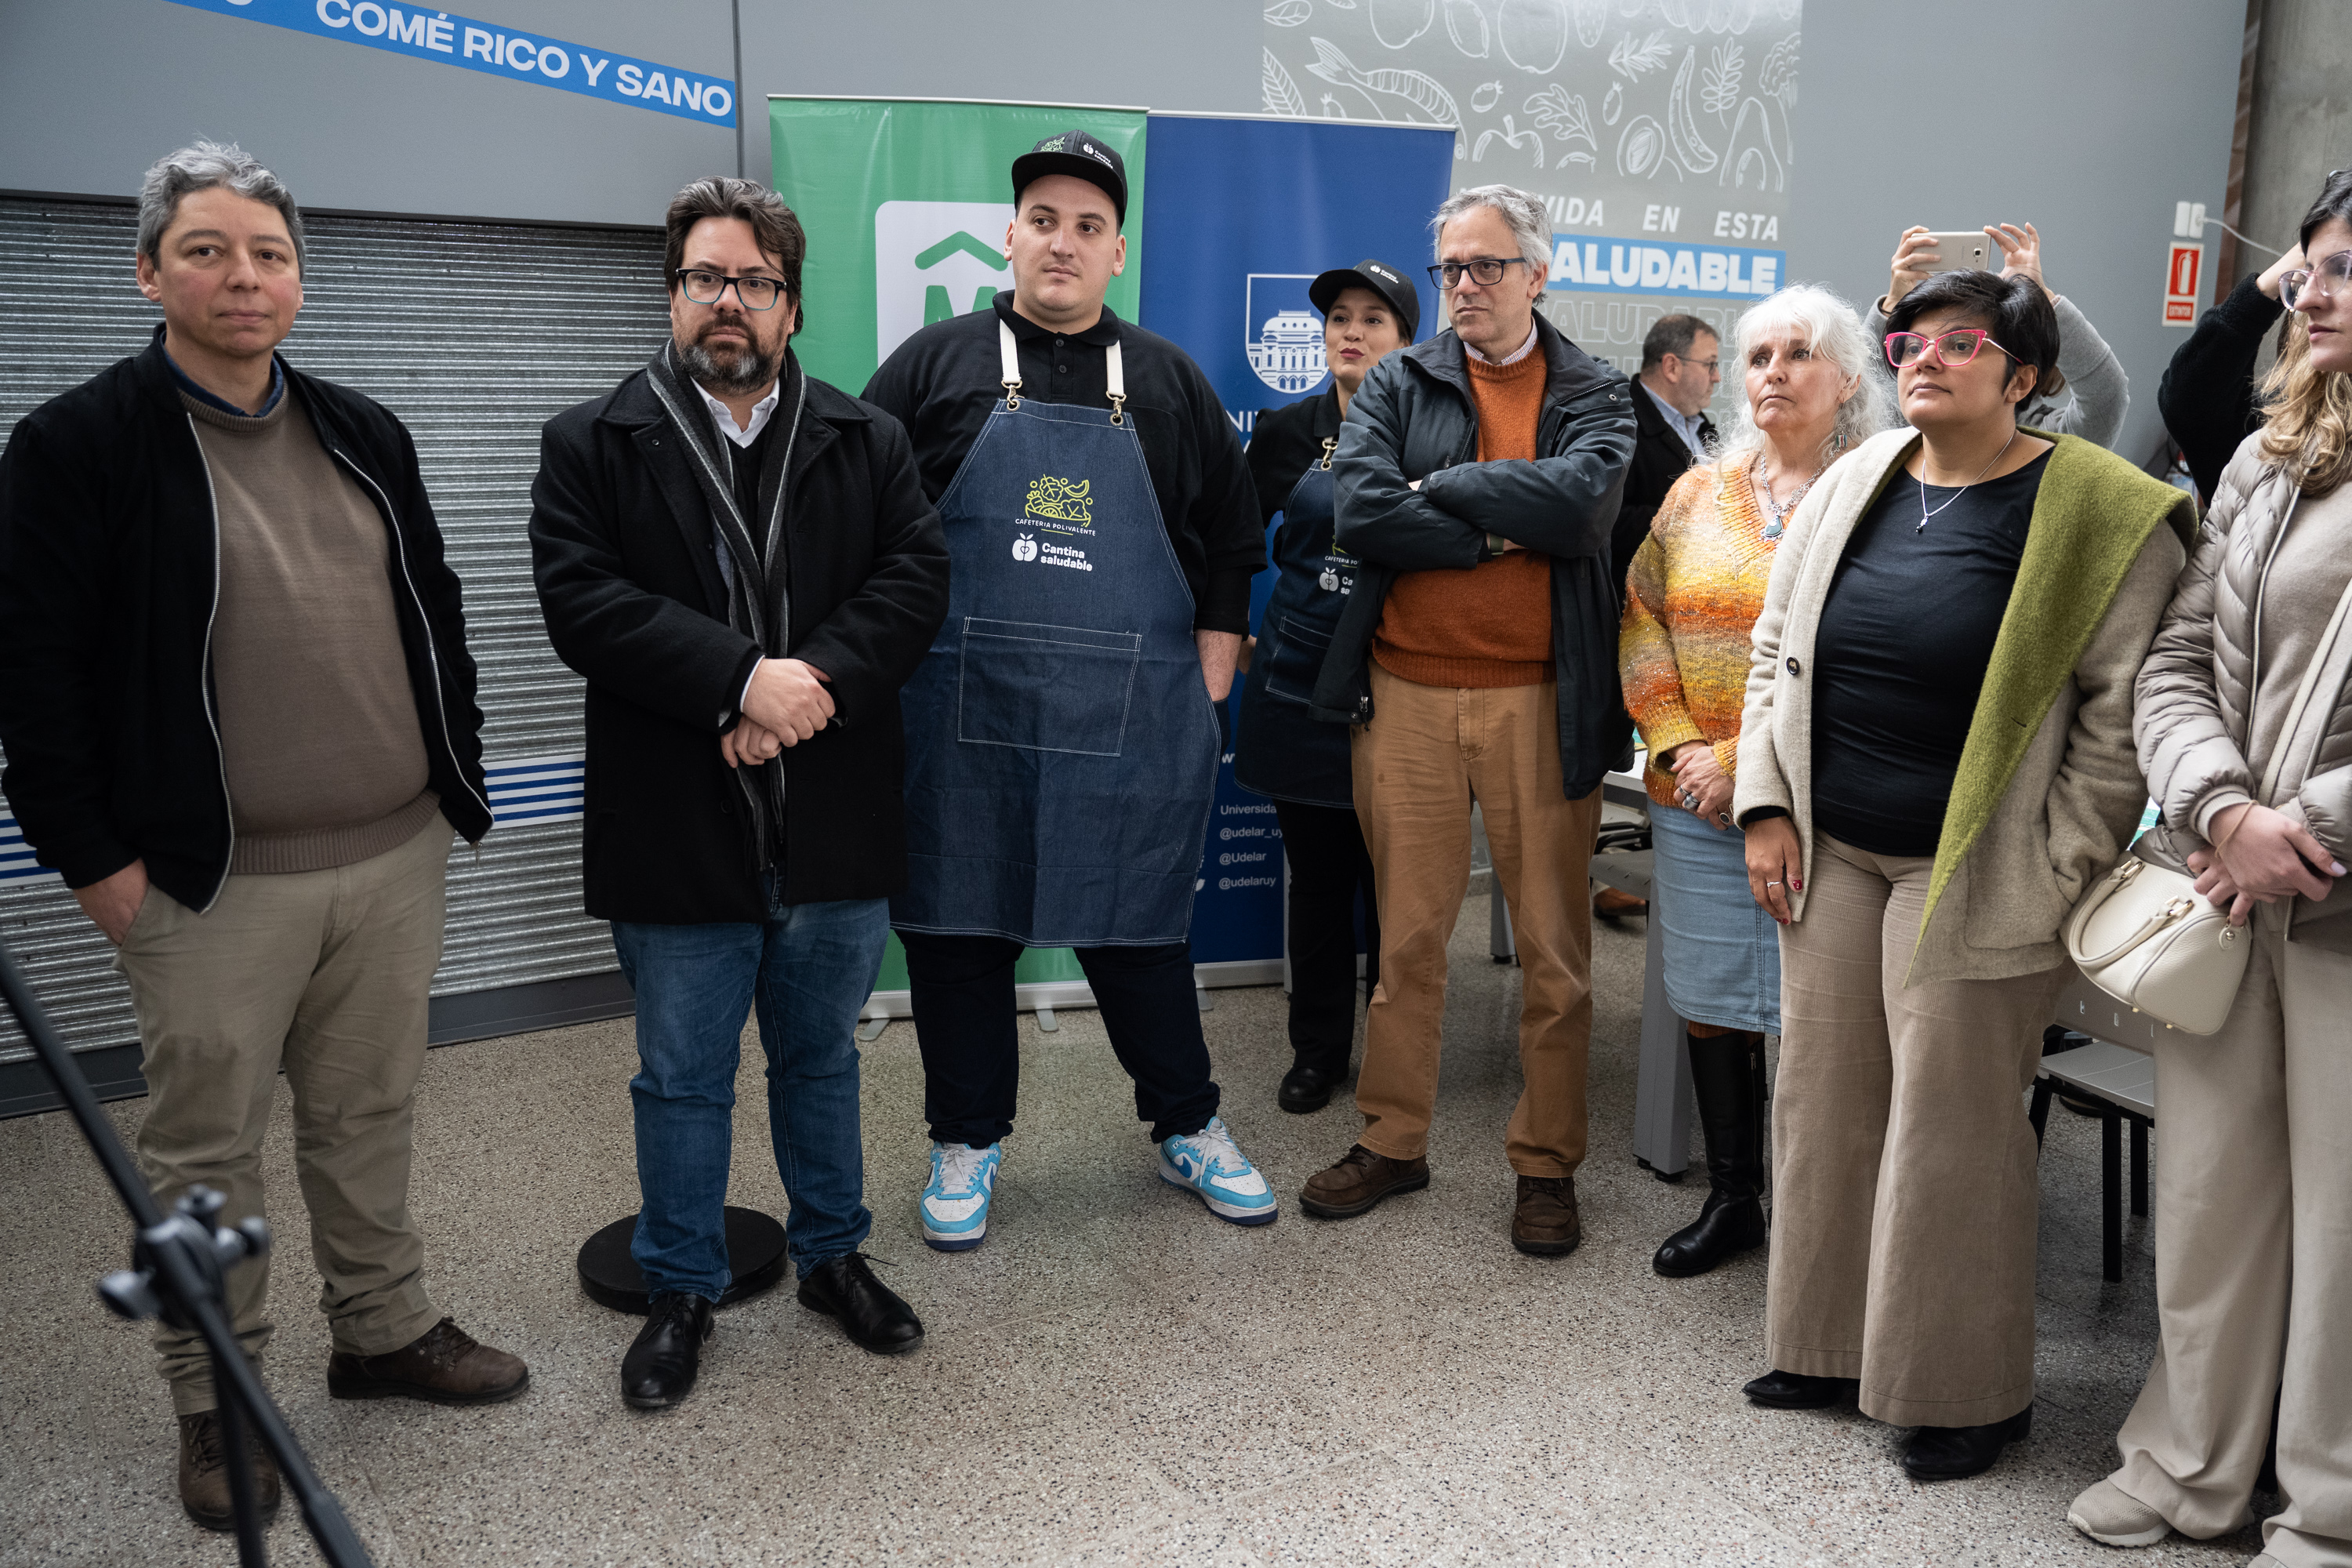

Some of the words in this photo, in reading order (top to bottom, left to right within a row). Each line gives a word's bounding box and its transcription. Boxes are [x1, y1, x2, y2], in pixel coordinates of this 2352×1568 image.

[316, 0, 455, 54] COMÉ
[463, 26, 570, 78] RICO
[579, 53, 610, 87] Y
[615, 64, 732, 117] SANO
[1642, 204, 1681, 233] EN
[1714, 210, 1778, 241] ESTA
[1014, 518, 1051, 528] CAFETERIA
[1052, 523, 1096, 536] POLIVALENTE
[1041, 543, 1085, 559] Cantina
[1040, 555, 1093, 572] saludable
[1324, 555, 1349, 564] CAFETERIA
[1220, 826, 1283, 840] @udelar_uy
[1219, 851, 1267, 866] @Udelar
[1218, 877, 1276, 890] @udelaruy
